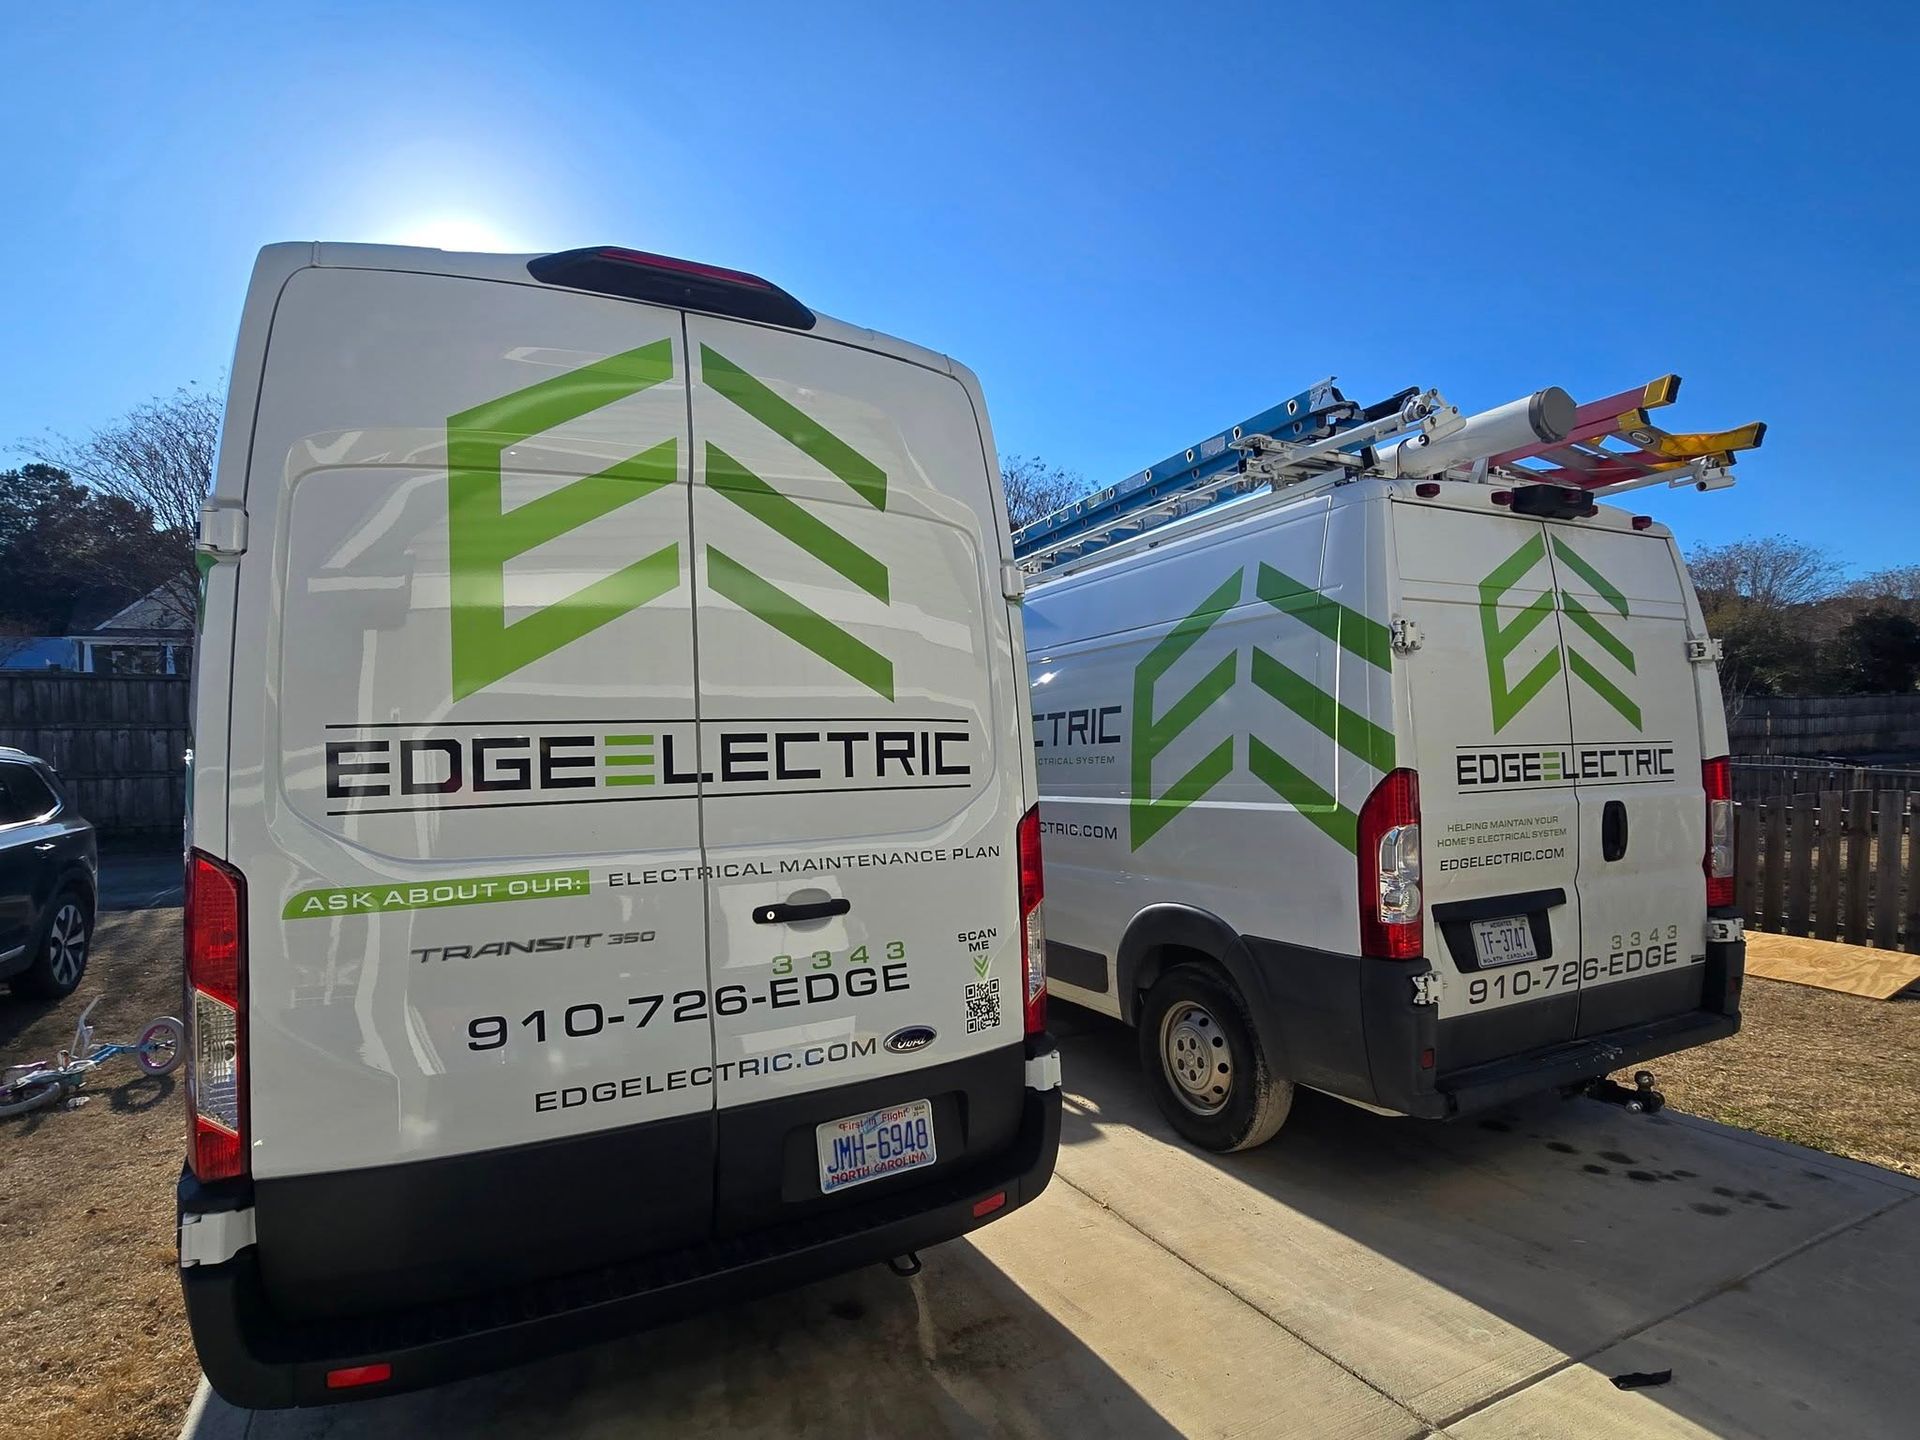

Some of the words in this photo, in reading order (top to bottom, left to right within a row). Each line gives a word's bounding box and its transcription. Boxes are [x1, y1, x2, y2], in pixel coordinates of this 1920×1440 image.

[325, 732, 971, 799] EDGEELECTRIC
[1076, 756, 1115, 765] SYSTEM
[1456, 748, 1675, 786] EDGEELECTRIC
[1437, 837, 1475, 848] HOME'S
[1477, 833, 1531, 844] ELECTRICAL
[1532, 828, 1567, 839] SYSTEM
[1447, 822, 1488, 833] HELPING
[1490, 818, 1533, 829] MAINTAIN
[1535, 816, 1559, 825] YOUR
[608, 862, 773, 887] ELECTRICAL
[780, 848, 947, 874] MAINTENANCE
[952, 845, 1001, 861] PLAN
[1440, 848, 1565, 872] EDGELECTRIC.COM
[302, 893, 373, 914] ASK
[382, 882, 499, 904] ABOUT
[508, 876, 581, 895] OUR:
[411, 933, 603, 963] TRANSIT
[607, 931, 656, 945] 350
[957, 928, 997, 943] SCAN
[968, 940, 989, 952] ME
[1480, 927, 1528, 955] TF-3747
[1469, 942, 1678, 1005] 910-726-EDGE
[467, 962, 911, 1052] 910-726-EDGE
[535, 1037, 878, 1113] EDGELECTRIC.COM
[838, 1120, 864, 1132] First
[882, 1109, 907, 1123] Flight
[827, 1118, 929, 1174] JMH-6948
[831, 1166, 870, 1185] NORTH
[875, 1152, 927, 1173] CAROLINA
